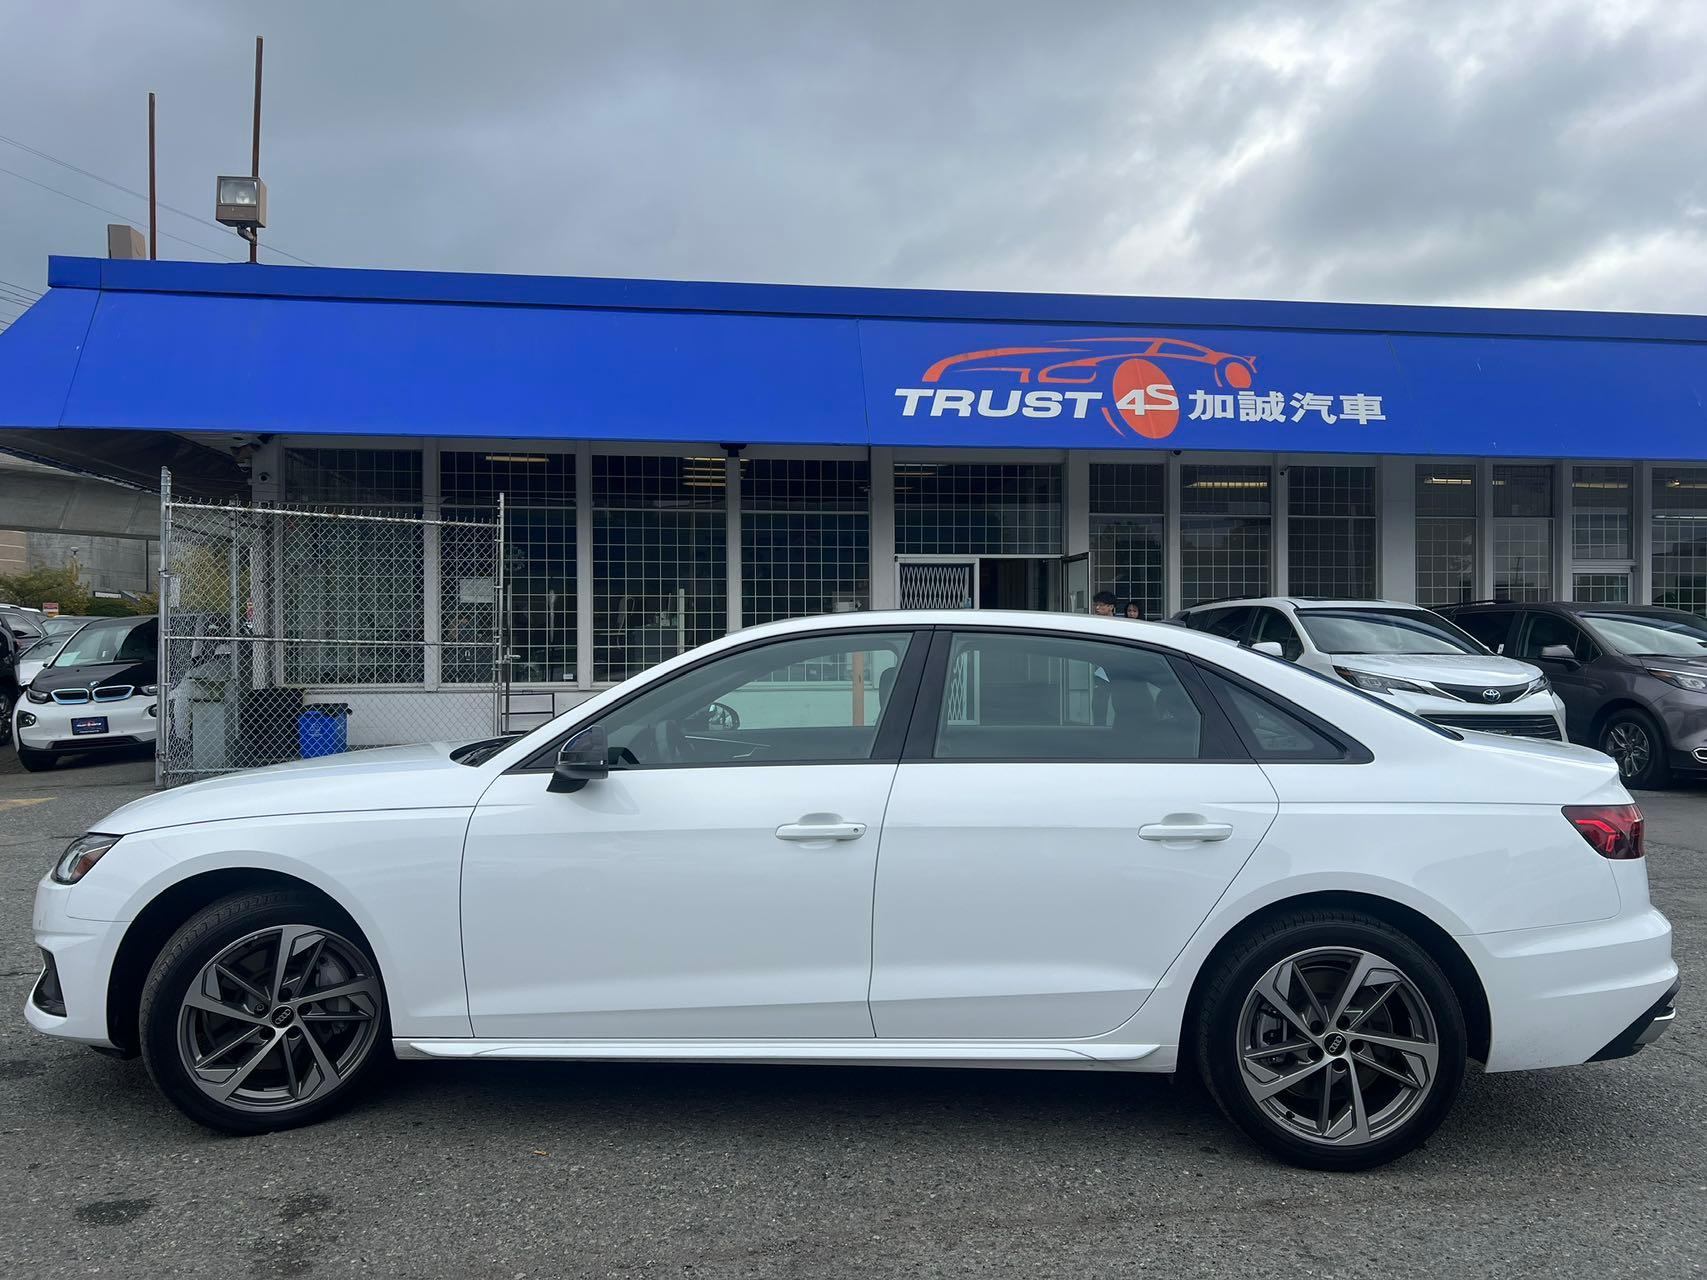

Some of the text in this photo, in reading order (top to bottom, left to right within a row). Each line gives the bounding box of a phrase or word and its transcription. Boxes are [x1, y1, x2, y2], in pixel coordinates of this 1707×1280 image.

[894, 383, 1180, 419] TRUST 4S
[1187, 389, 1386, 425] 加誠汽車
